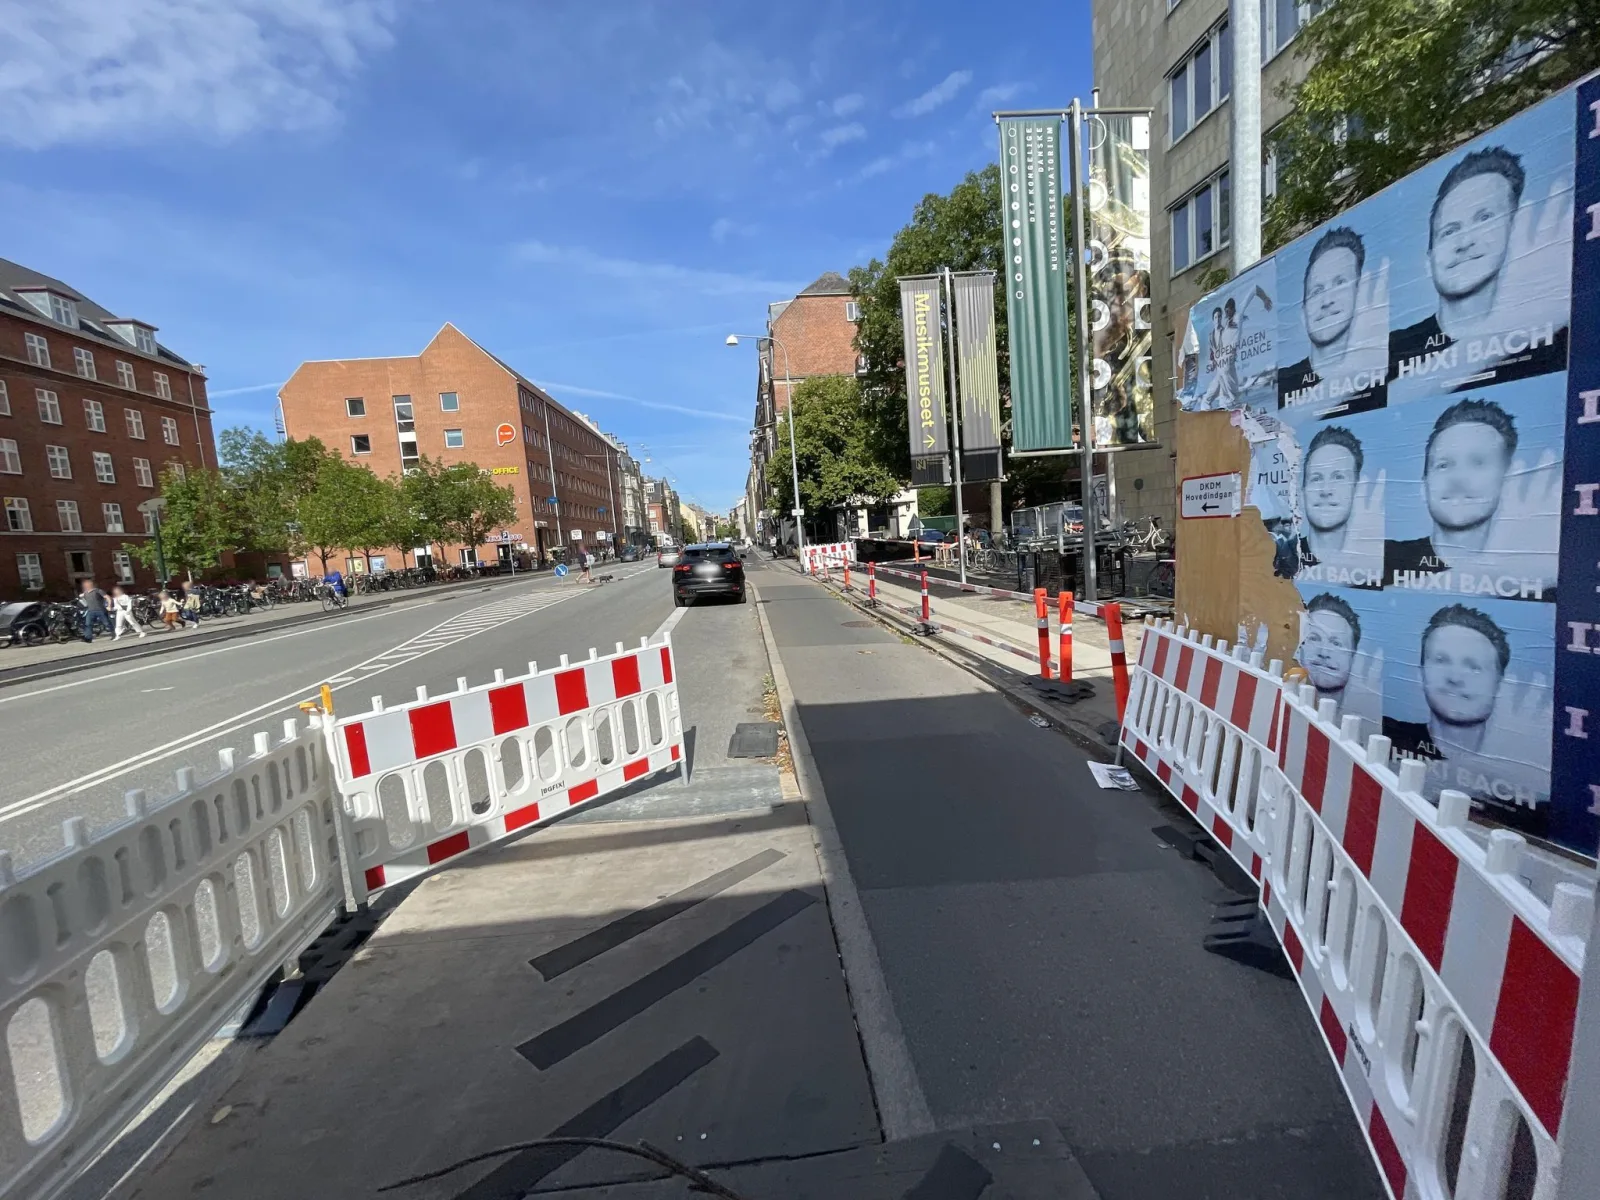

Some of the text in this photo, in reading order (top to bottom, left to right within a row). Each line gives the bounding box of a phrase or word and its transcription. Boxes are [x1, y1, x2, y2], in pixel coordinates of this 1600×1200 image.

[1025, 127, 1035, 195] KONGELIGE
[1036, 127, 1045, 173] DANSKE
[1046, 126, 1058, 271] MUSIKKONSERVATORIUM
[914, 293, 935, 428] Musikmuseet
[1209, 330, 1266, 360] OPENHAGEN
[1240, 340, 1272, 361] DANCE
[1398, 348, 1458, 379] HUXI
[1466, 321, 1554, 364] BACH
[1284, 369, 1386, 409] HUXI BACH
[1185, 490, 1234, 501] Hovedindgan
[1199, 481, 1222, 491] DKDM
[1326, 566, 1382, 587] BACH
[1393, 569, 1543, 599] HUXI BACH
[1457, 765, 1537, 810] BACH
